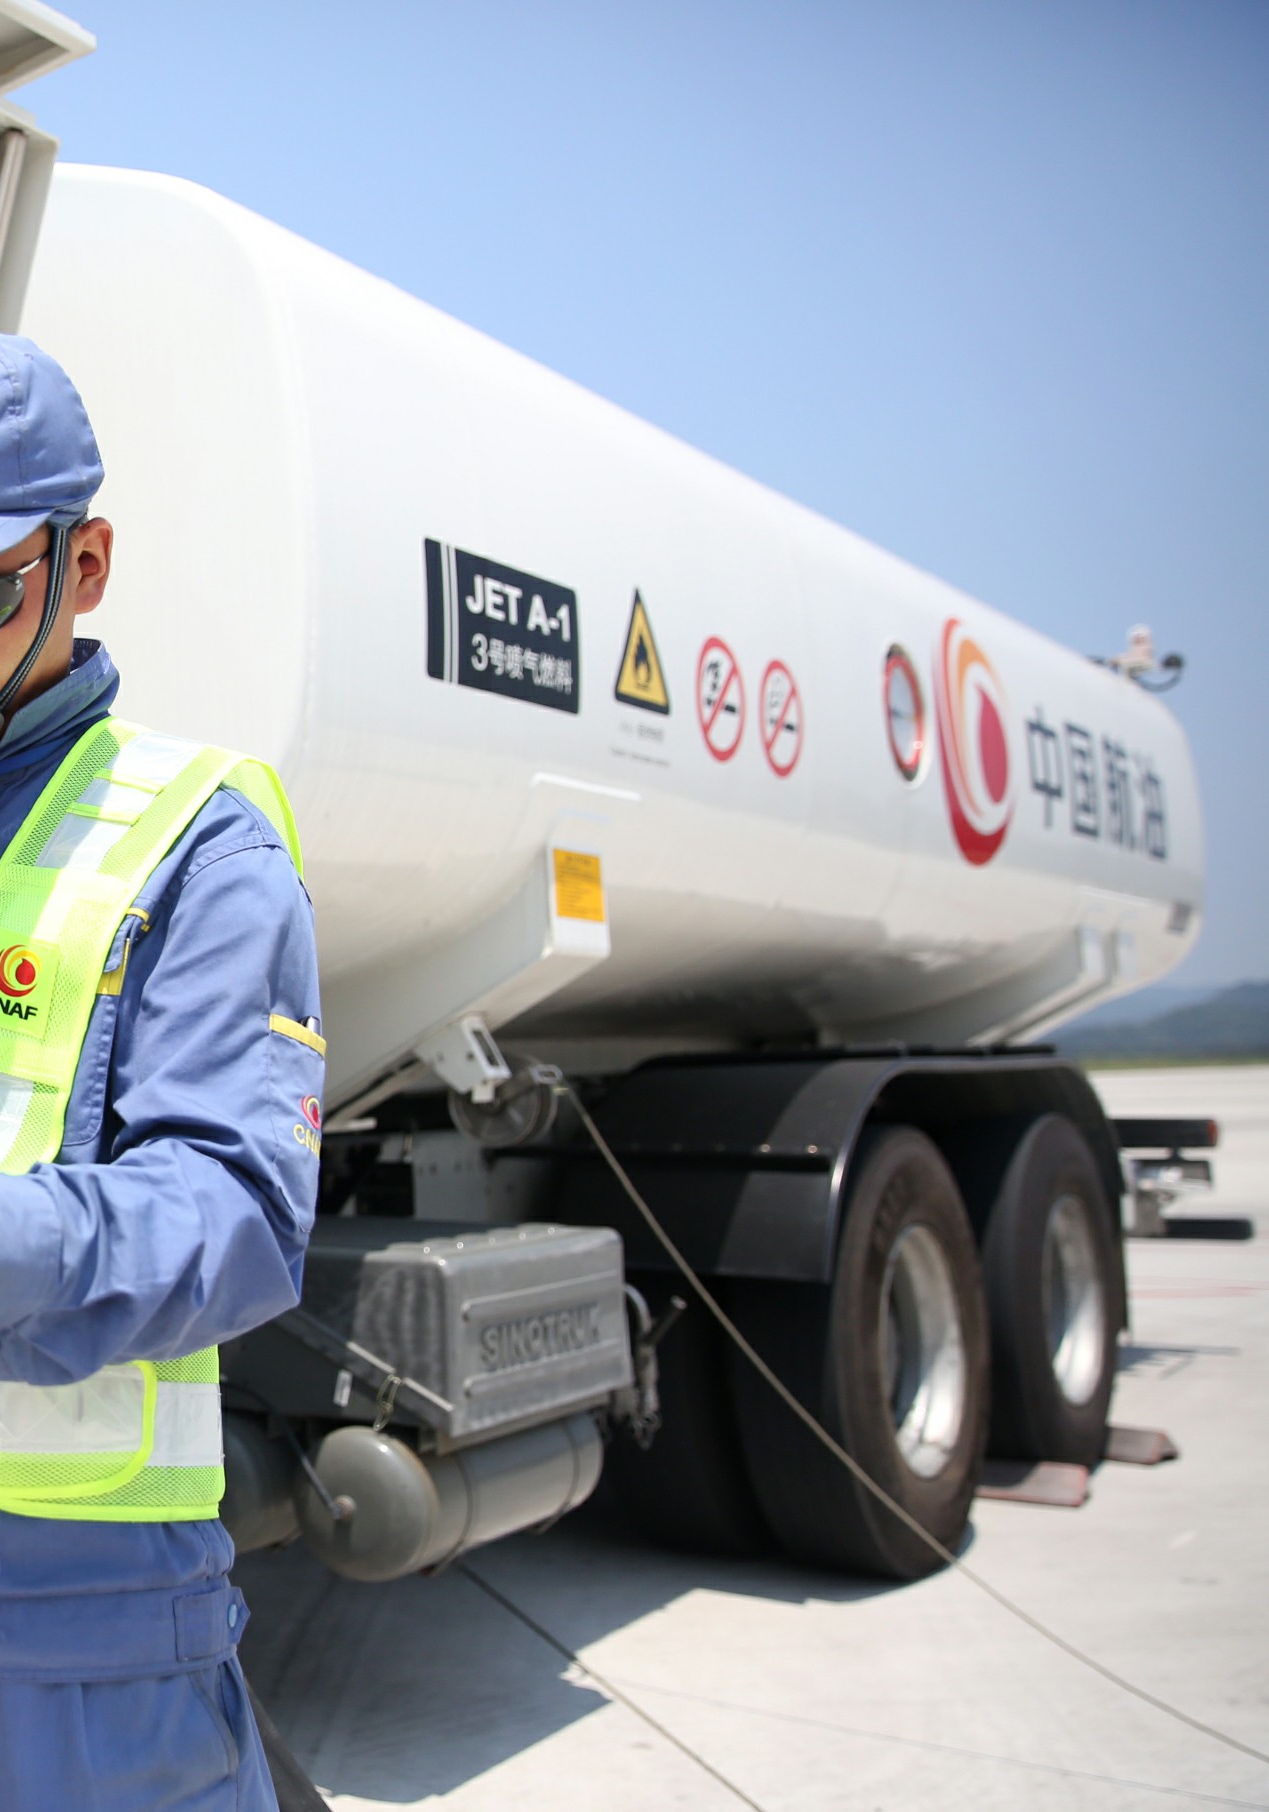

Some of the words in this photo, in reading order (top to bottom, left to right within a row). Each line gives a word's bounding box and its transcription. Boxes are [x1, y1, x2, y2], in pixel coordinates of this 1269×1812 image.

[465, 574, 522, 626] JET
[527, 594, 572, 643] A-1
[470, 632, 574, 696] 3号喷气燃料
[1024, 703, 1169, 862] 中国航油
